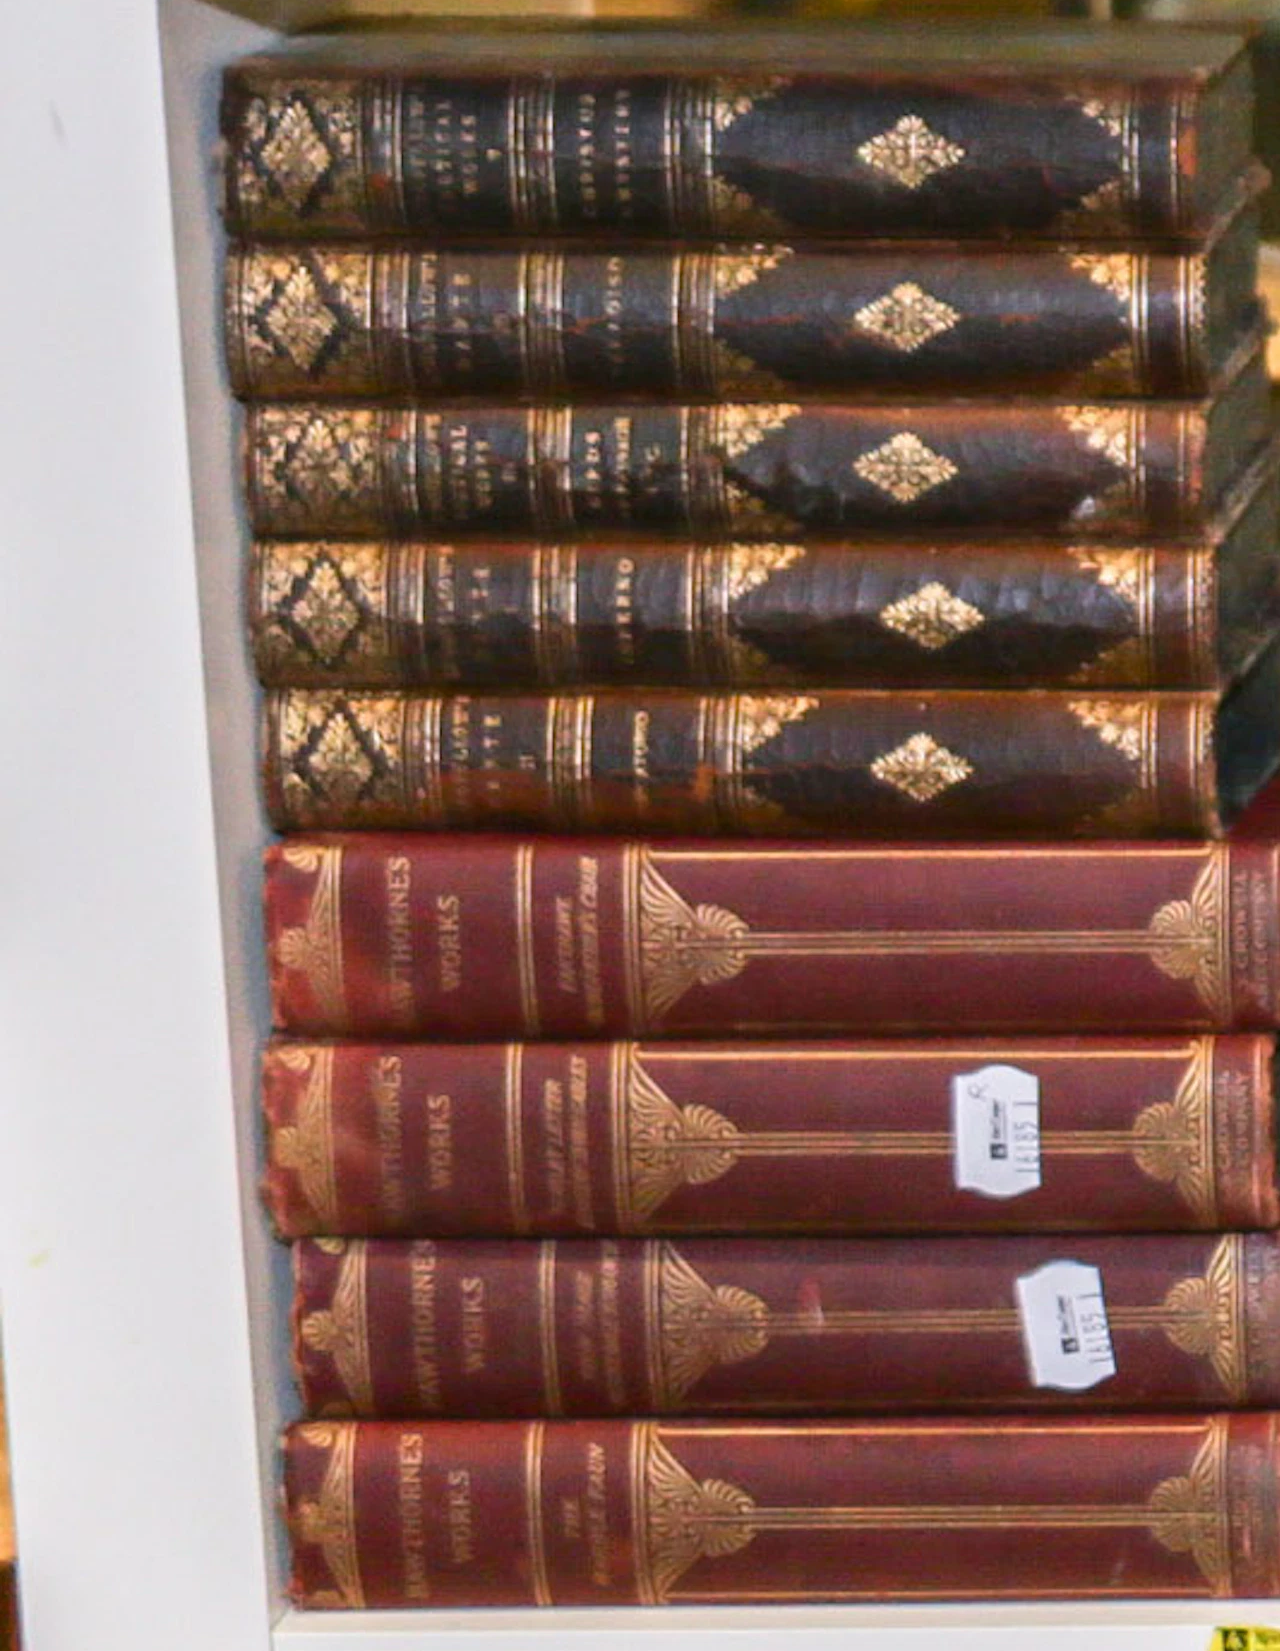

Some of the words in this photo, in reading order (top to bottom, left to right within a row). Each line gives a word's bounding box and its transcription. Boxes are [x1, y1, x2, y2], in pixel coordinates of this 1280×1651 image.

[437, 893, 462, 993] WORKS
[427, 1093, 453, 1192] WORKS
[459, 1276, 485, 1374] WORKS
[448, 1468, 473, 1564] WORKS
